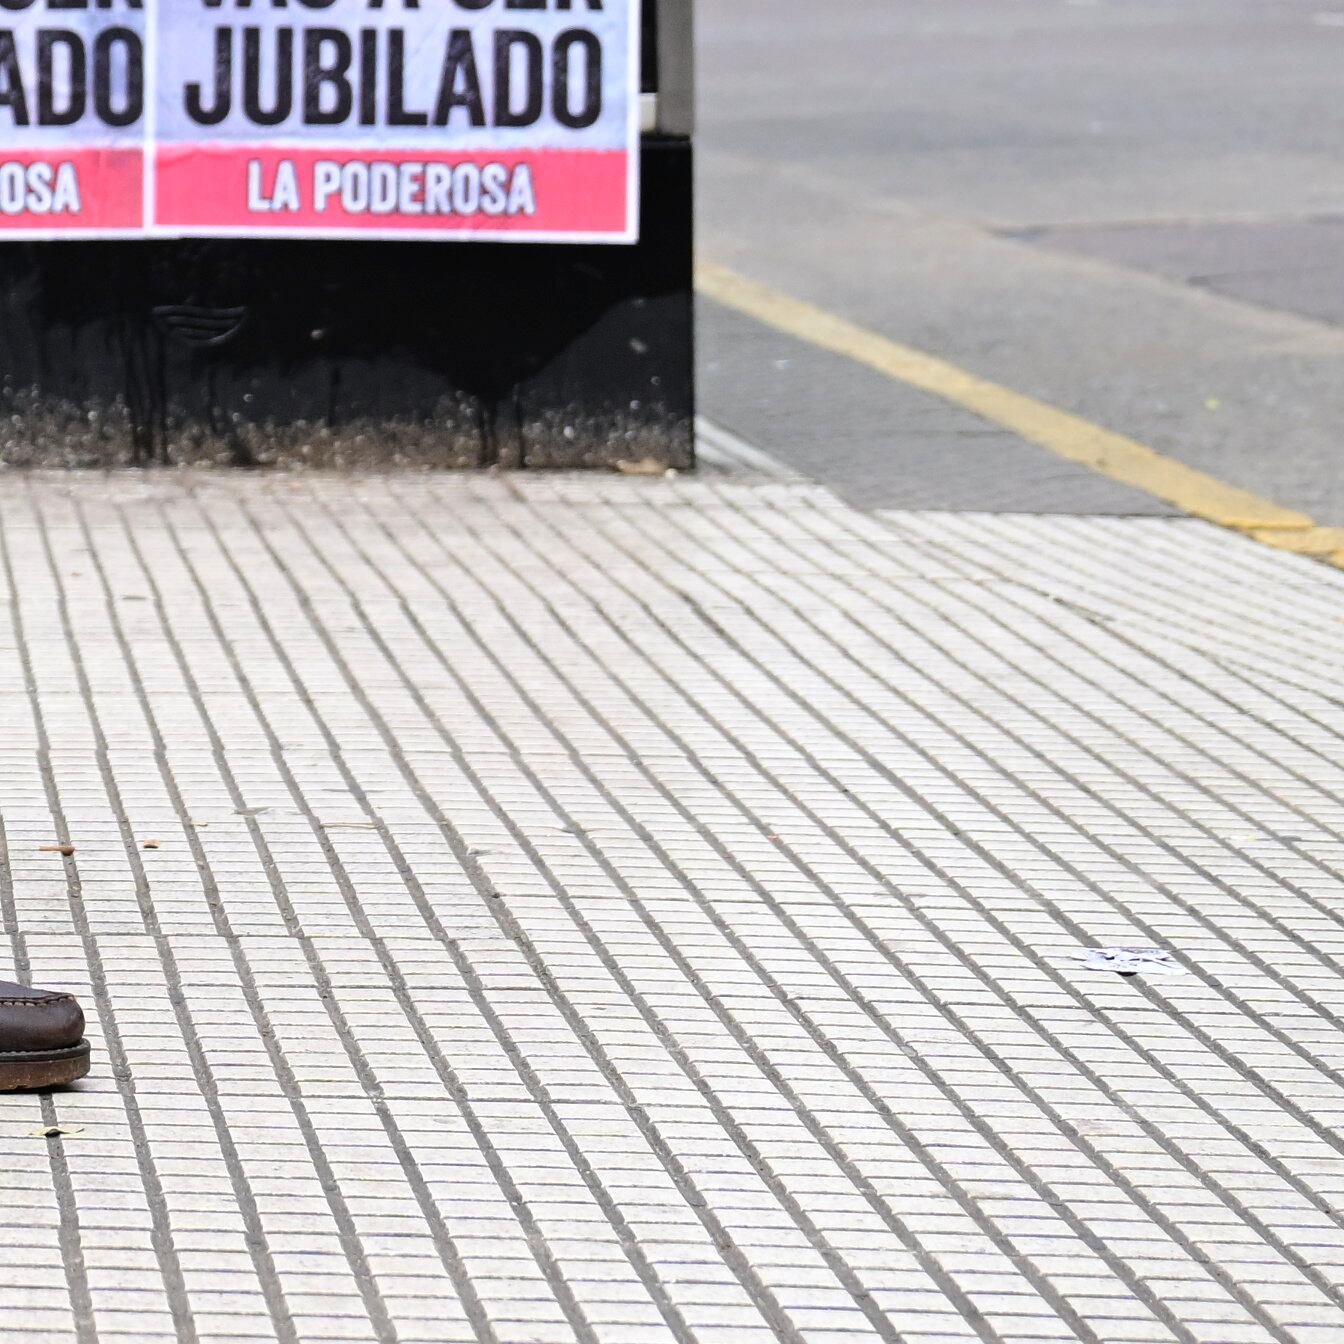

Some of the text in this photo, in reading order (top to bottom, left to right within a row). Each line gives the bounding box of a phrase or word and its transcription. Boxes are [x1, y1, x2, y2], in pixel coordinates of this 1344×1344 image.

[185, 26, 601, 129] JUBILADO
[249, 162, 535, 214] LA PODEROSA
